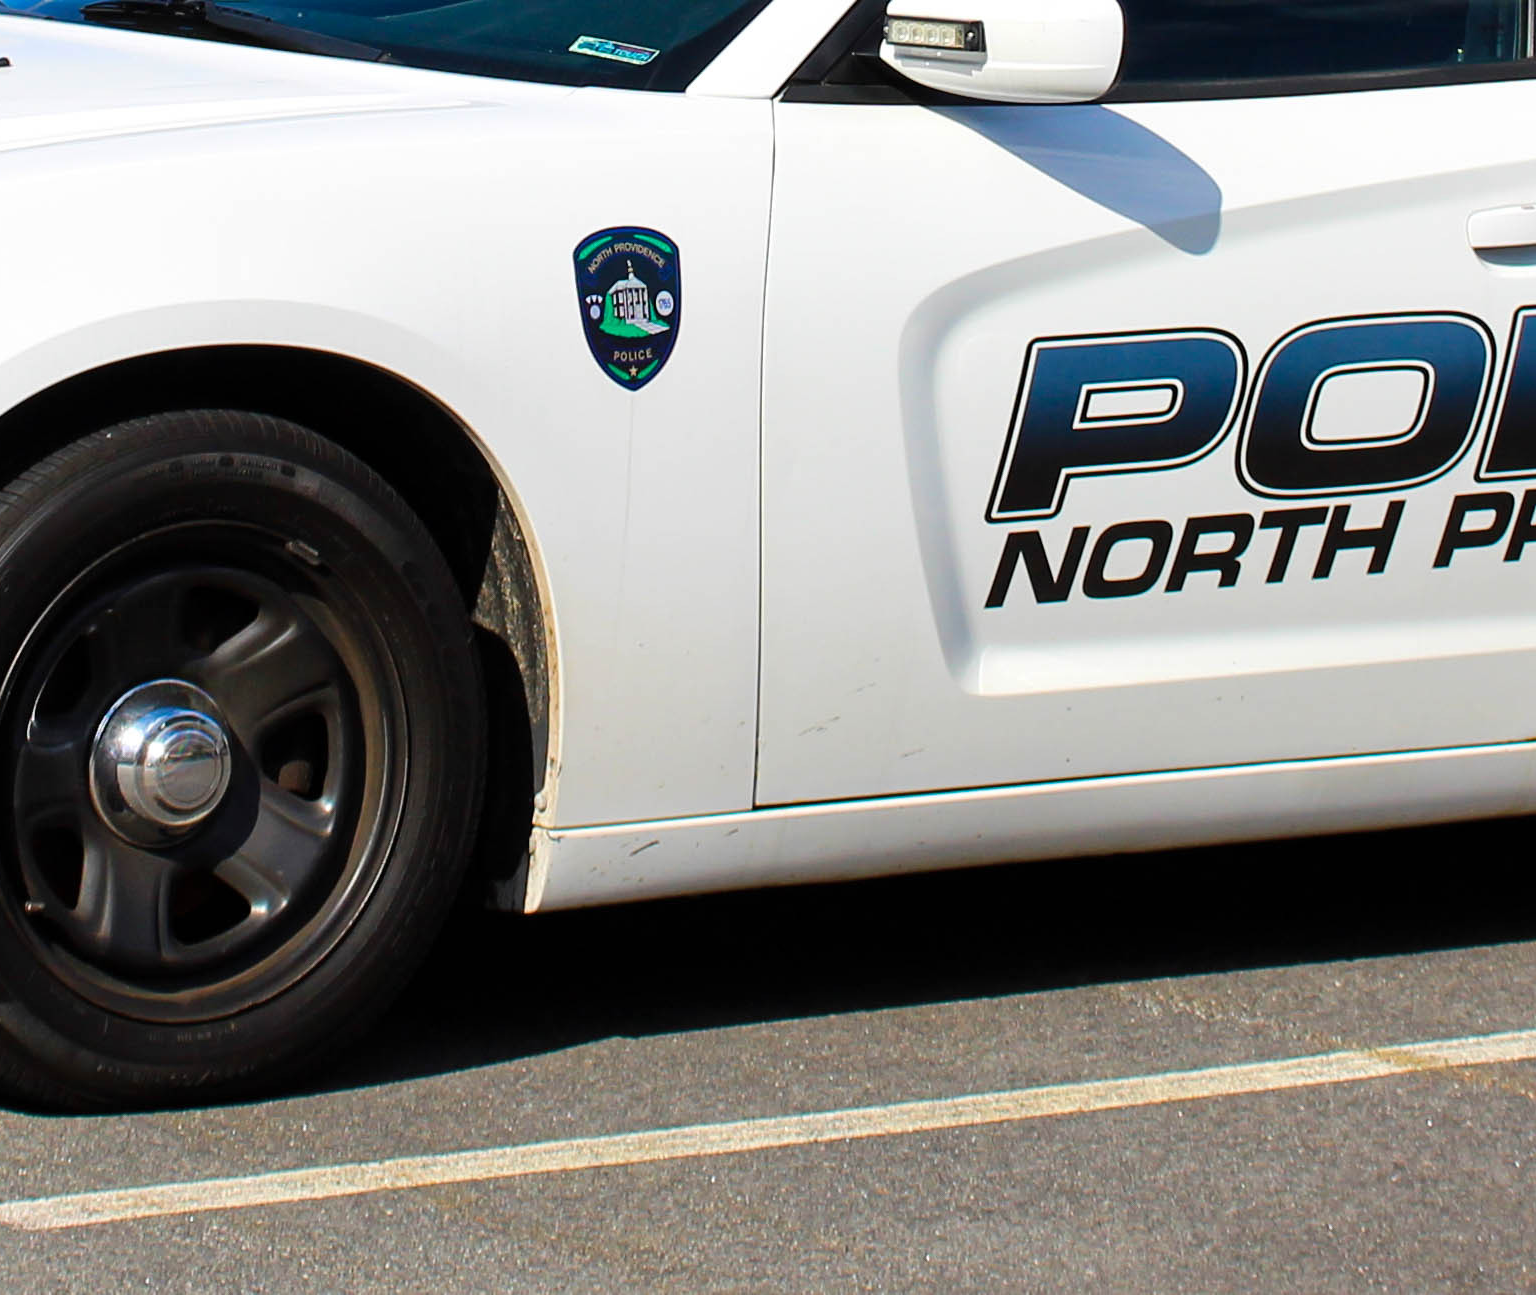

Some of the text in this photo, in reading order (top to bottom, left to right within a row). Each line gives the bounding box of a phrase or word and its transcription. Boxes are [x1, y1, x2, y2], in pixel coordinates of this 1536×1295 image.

[588, 243, 666, 274] NORTH PROVIDENCE
[613, 348, 653, 361] POLICE
[986, 499, 1406, 609] NORTH
